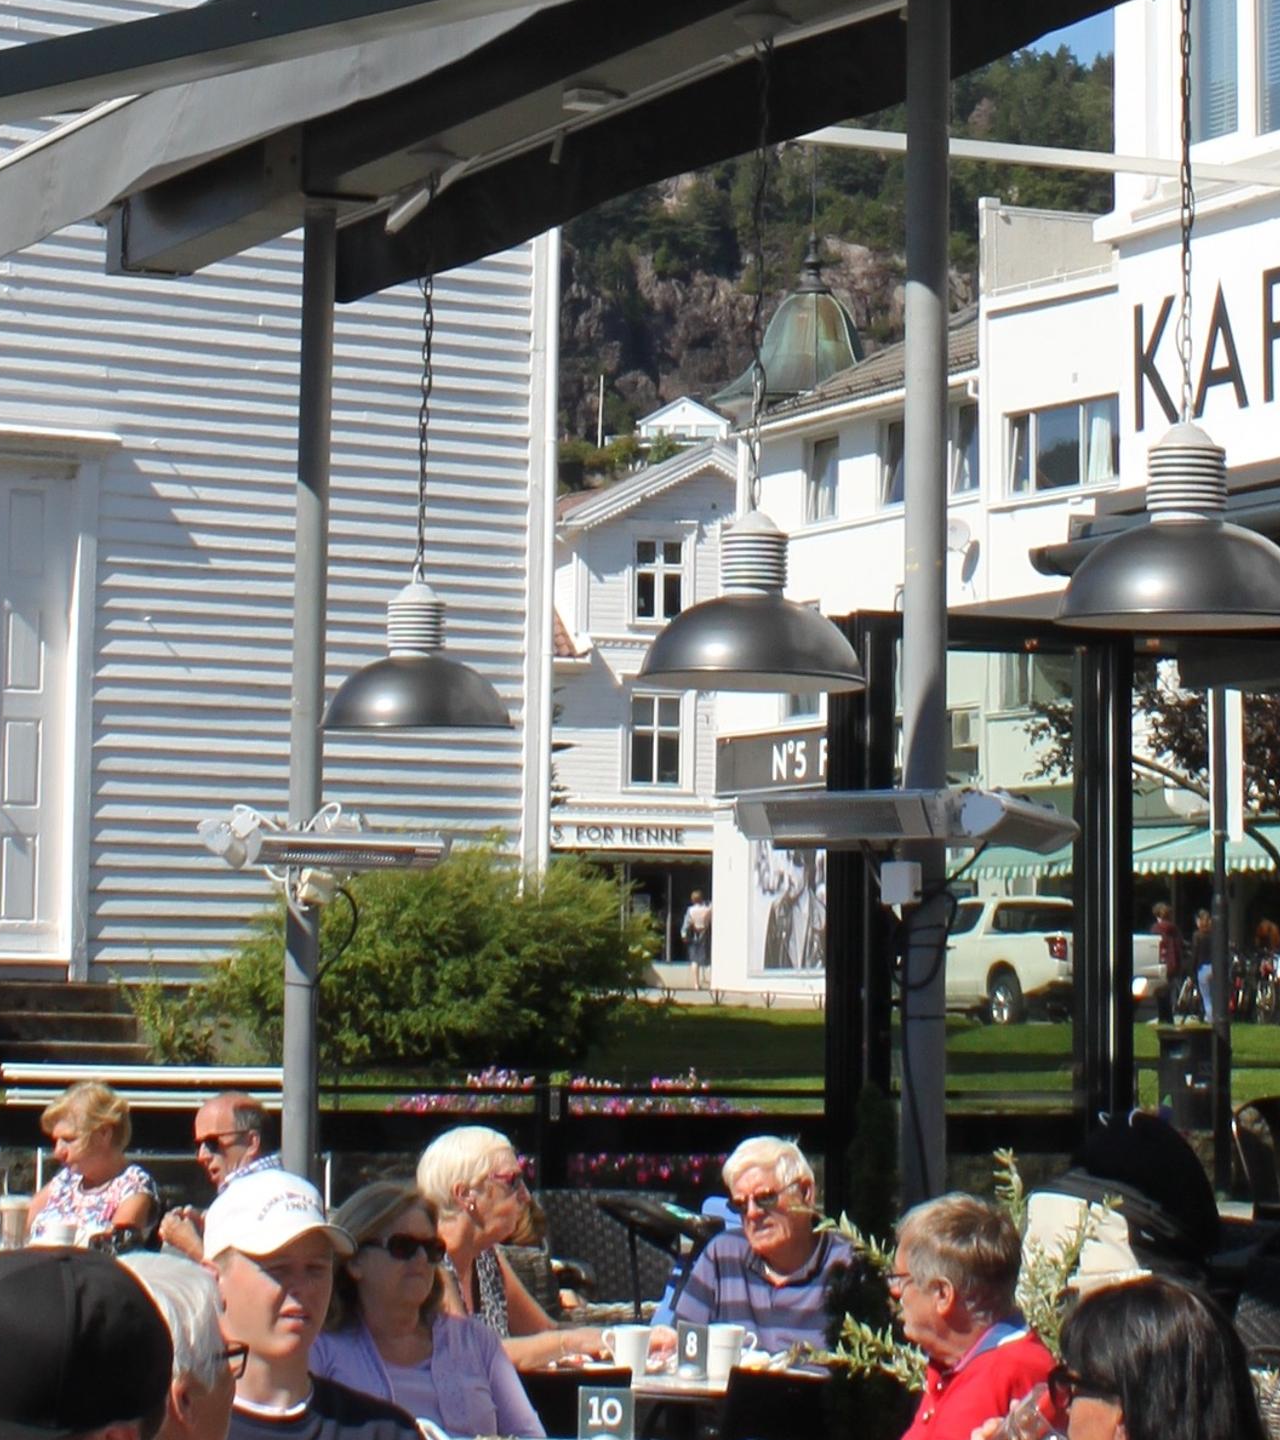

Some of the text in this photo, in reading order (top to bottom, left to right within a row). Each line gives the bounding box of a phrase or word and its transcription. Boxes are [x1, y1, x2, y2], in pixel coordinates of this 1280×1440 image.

[576, 825, 615, 842] FOR
[622, 826, 686, 845] HENNE
[685, 1330, 698, 1358] 8
[587, 1395, 623, 1426] 10
